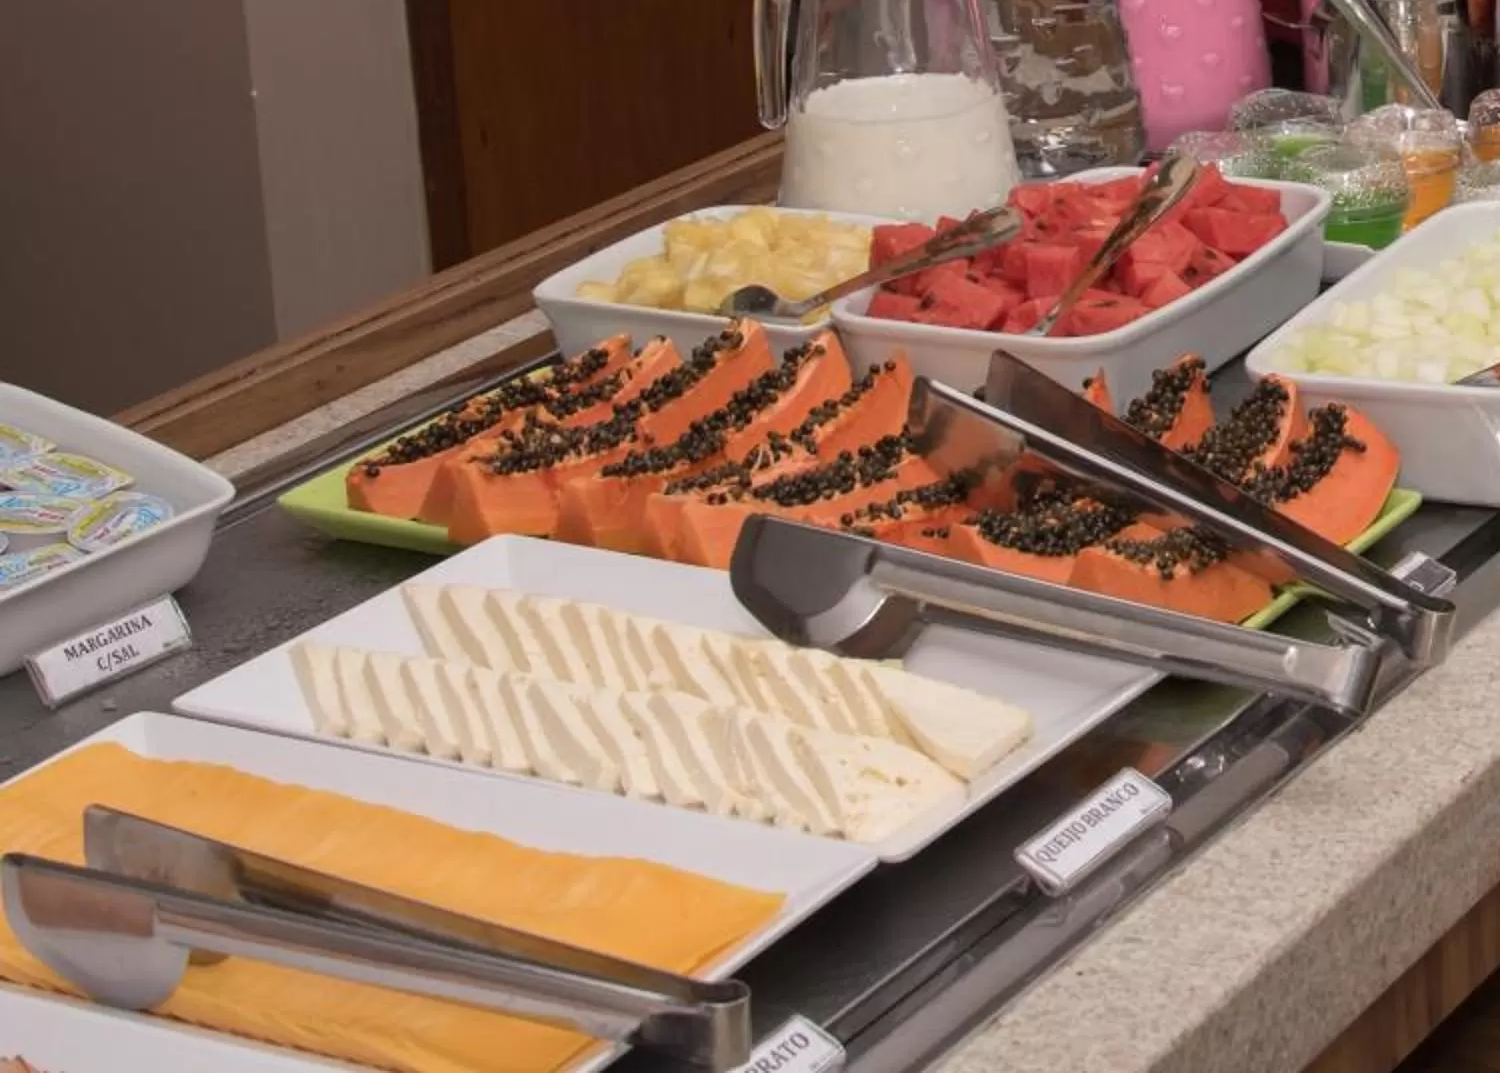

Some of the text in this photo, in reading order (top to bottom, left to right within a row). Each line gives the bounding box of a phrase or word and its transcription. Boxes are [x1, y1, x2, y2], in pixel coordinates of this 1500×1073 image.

[63, 614, 152, 662] MARGARINA
[97, 643, 140, 672] C/SAL
[1035, 781, 1141, 863] QUEIJO BRANCO
[744, 1032, 810, 1073] RATO
